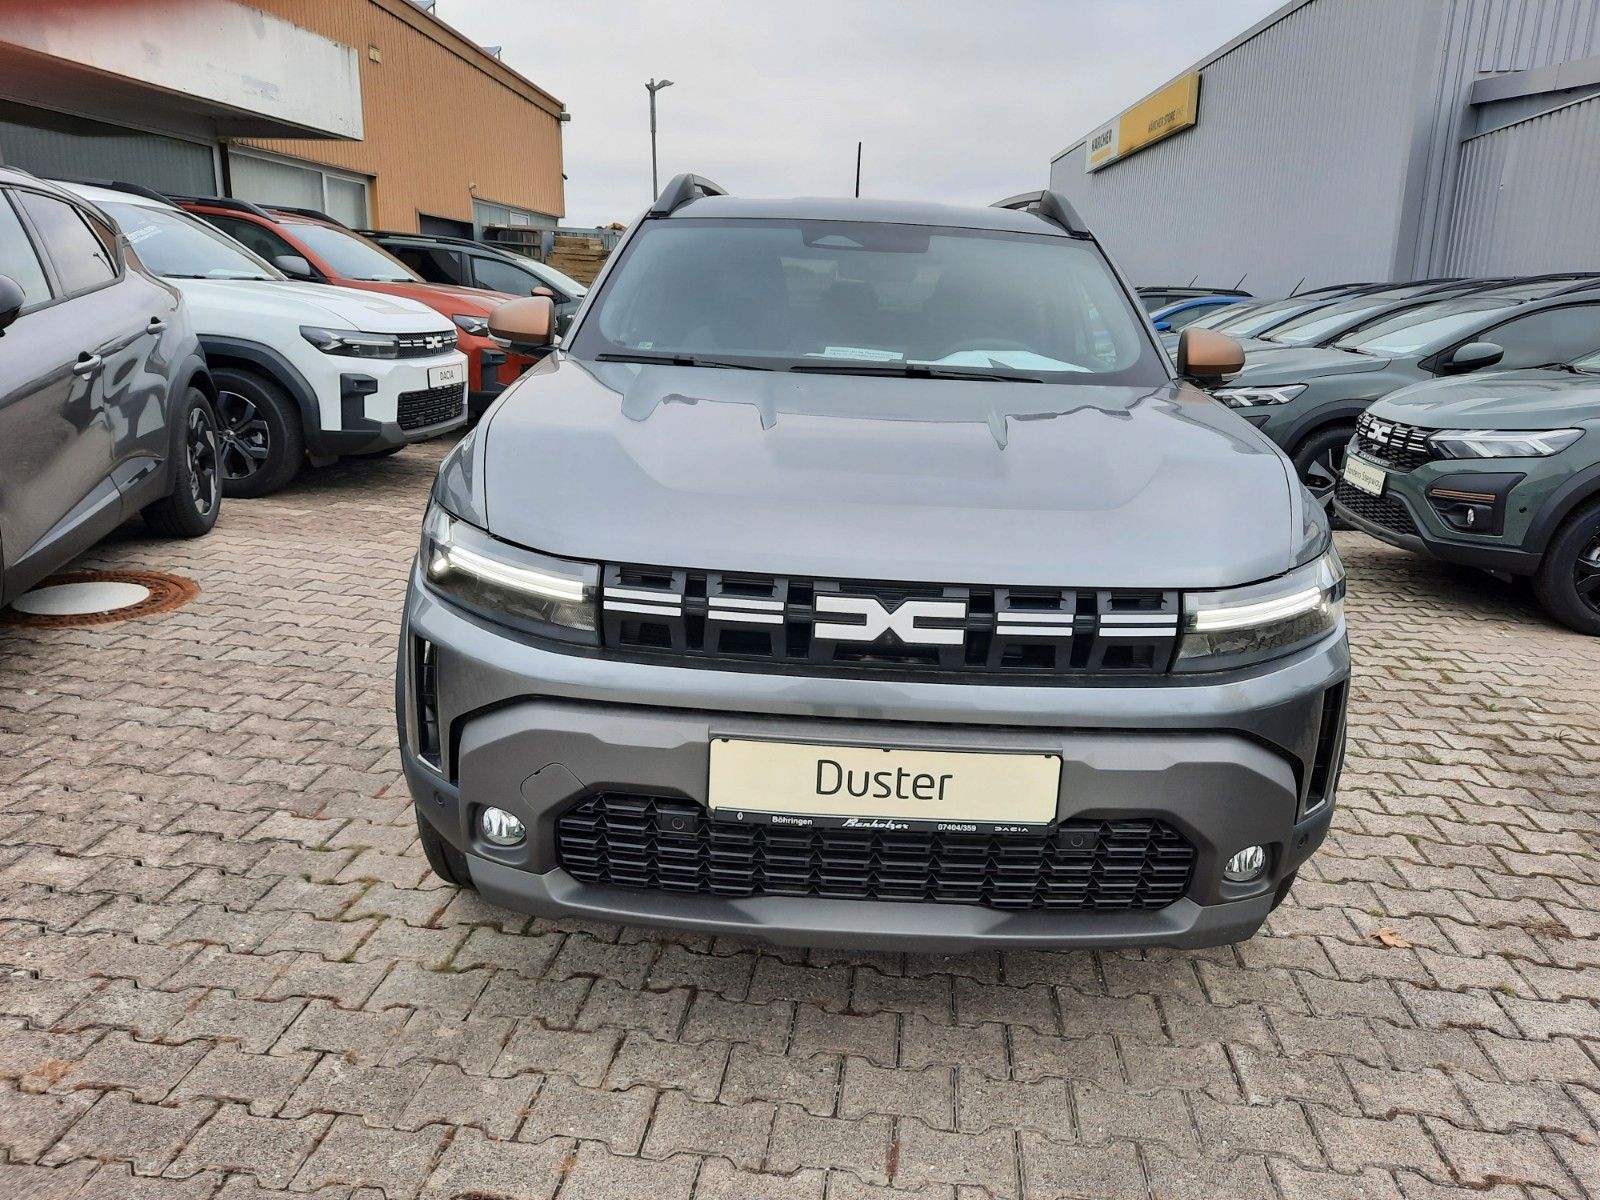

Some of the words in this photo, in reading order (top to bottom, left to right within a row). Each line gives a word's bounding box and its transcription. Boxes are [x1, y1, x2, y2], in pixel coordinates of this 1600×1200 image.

[439, 369, 455, 381] DACIA
[815, 759, 953, 801] Duster
[771, 815, 813, 826] Böhringen
[841, 818, 910, 830] Banholzer
[937, 823, 977, 832] 07404/359
